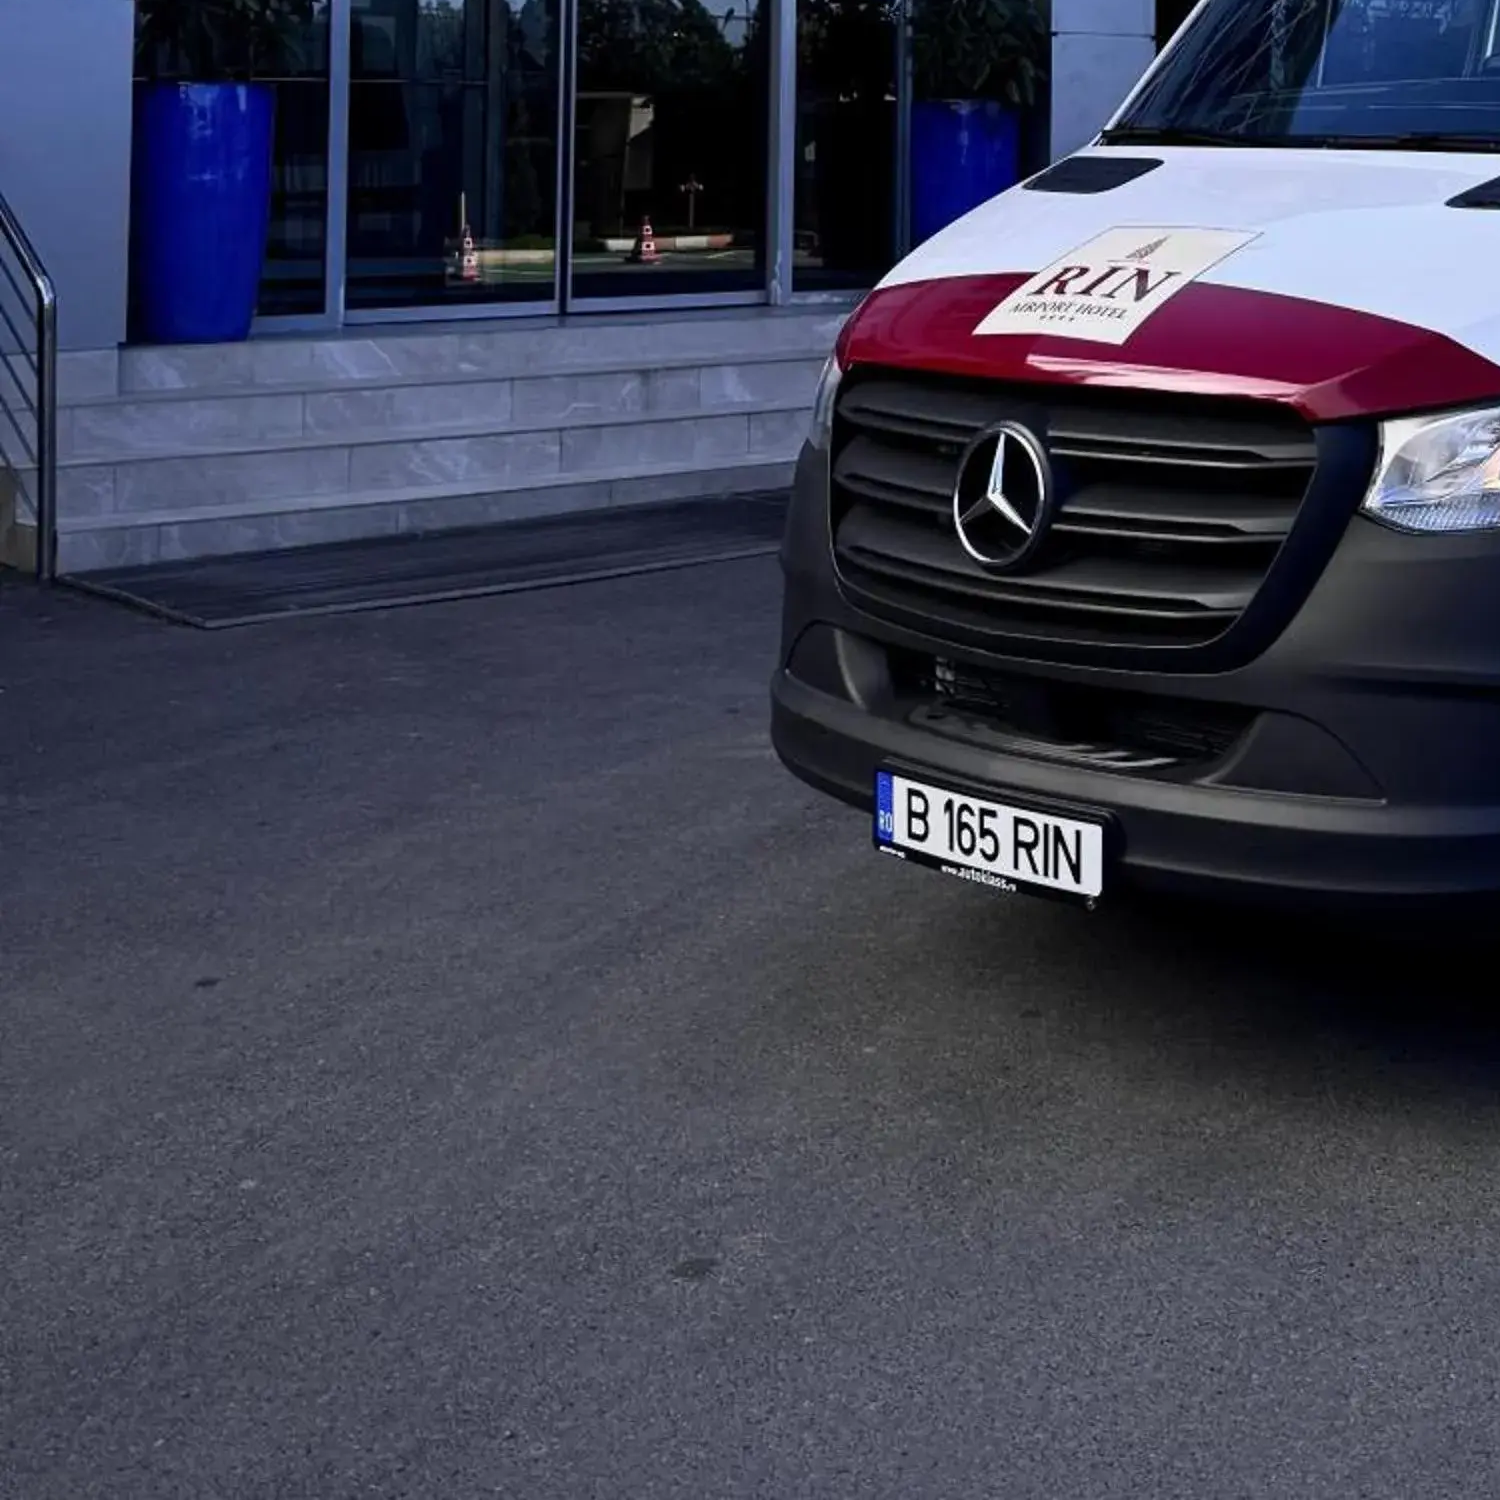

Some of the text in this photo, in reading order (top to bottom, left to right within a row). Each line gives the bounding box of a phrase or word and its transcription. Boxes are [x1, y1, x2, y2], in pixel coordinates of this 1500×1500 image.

[1027, 266, 1182, 303] RIN
[1010, 301, 1129, 320] AIRPORT HOTEL
[907, 787, 1082, 885] B 165 RIN
